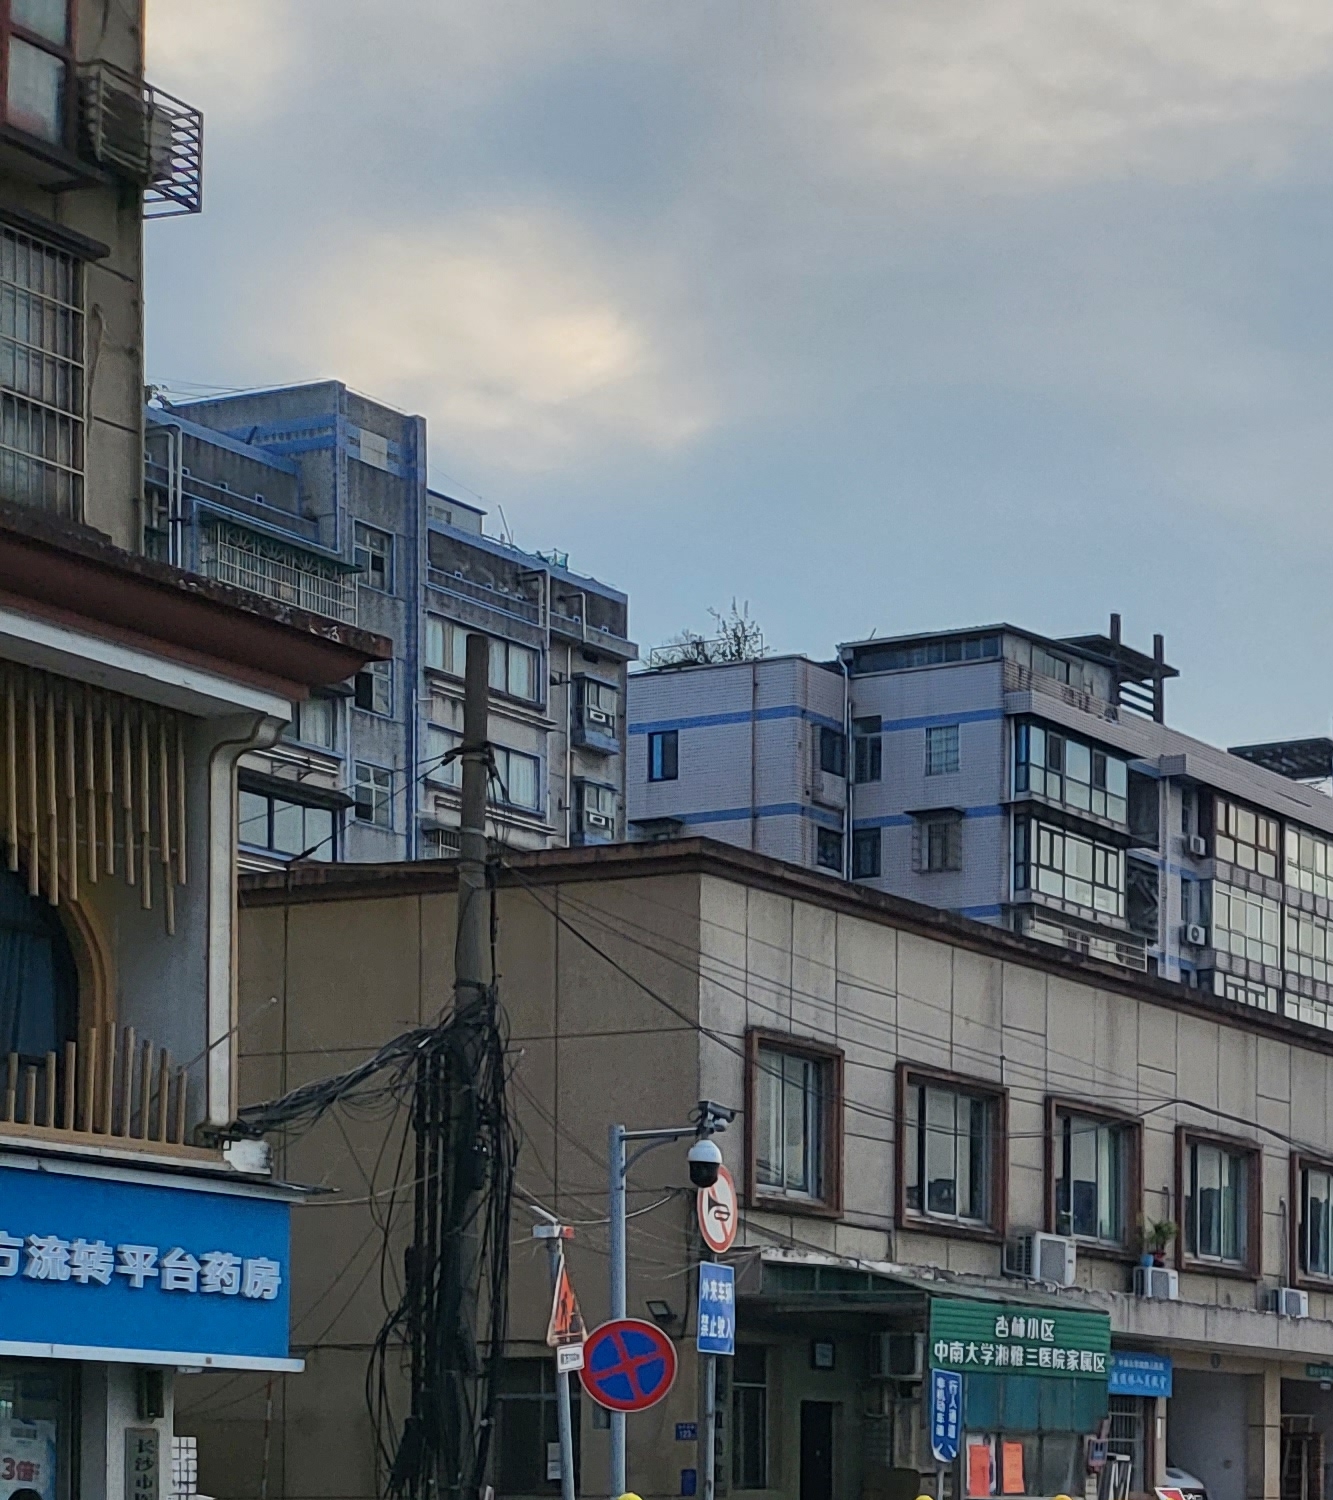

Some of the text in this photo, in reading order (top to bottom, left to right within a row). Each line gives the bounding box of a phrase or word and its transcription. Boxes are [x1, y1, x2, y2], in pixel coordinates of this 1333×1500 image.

[702, 1278, 733, 1306] 外来车辆
[701, 1313, 733, 1339] 禁止驶入
[995, 1315, 1055, 1342] 杏林小区
[934, 1339, 1106, 1373] 中南大学湘雅三医院家属区
